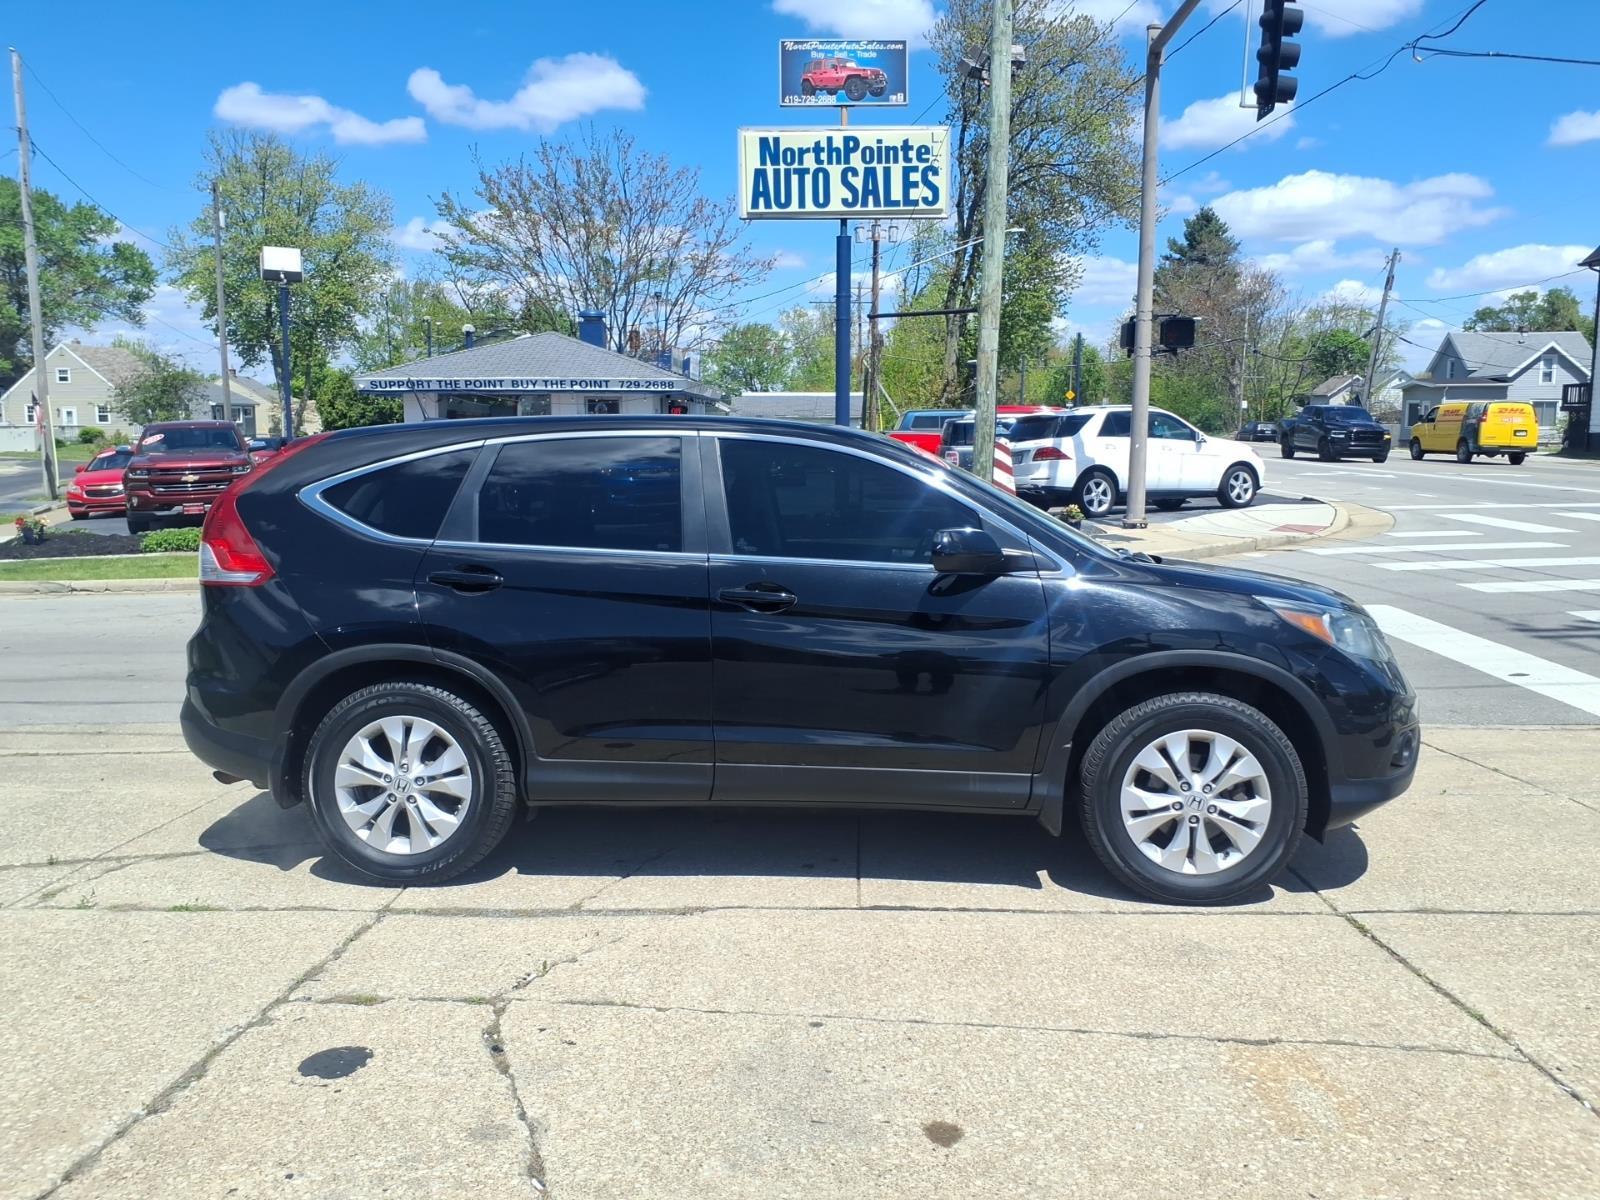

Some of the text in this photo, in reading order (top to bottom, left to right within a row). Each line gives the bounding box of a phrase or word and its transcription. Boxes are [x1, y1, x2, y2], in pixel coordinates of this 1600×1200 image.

[783, 41, 904, 50] NorthPointeAutoSales.com
[810, 51, 825, 59] Buy
[759, 135, 931, 166] NorthPointe
[751, 166, 940, 210] AUTO SALES
[370, 379, 675, 389] SUPPORT THE POINT BUY THE POINT 729-2688
